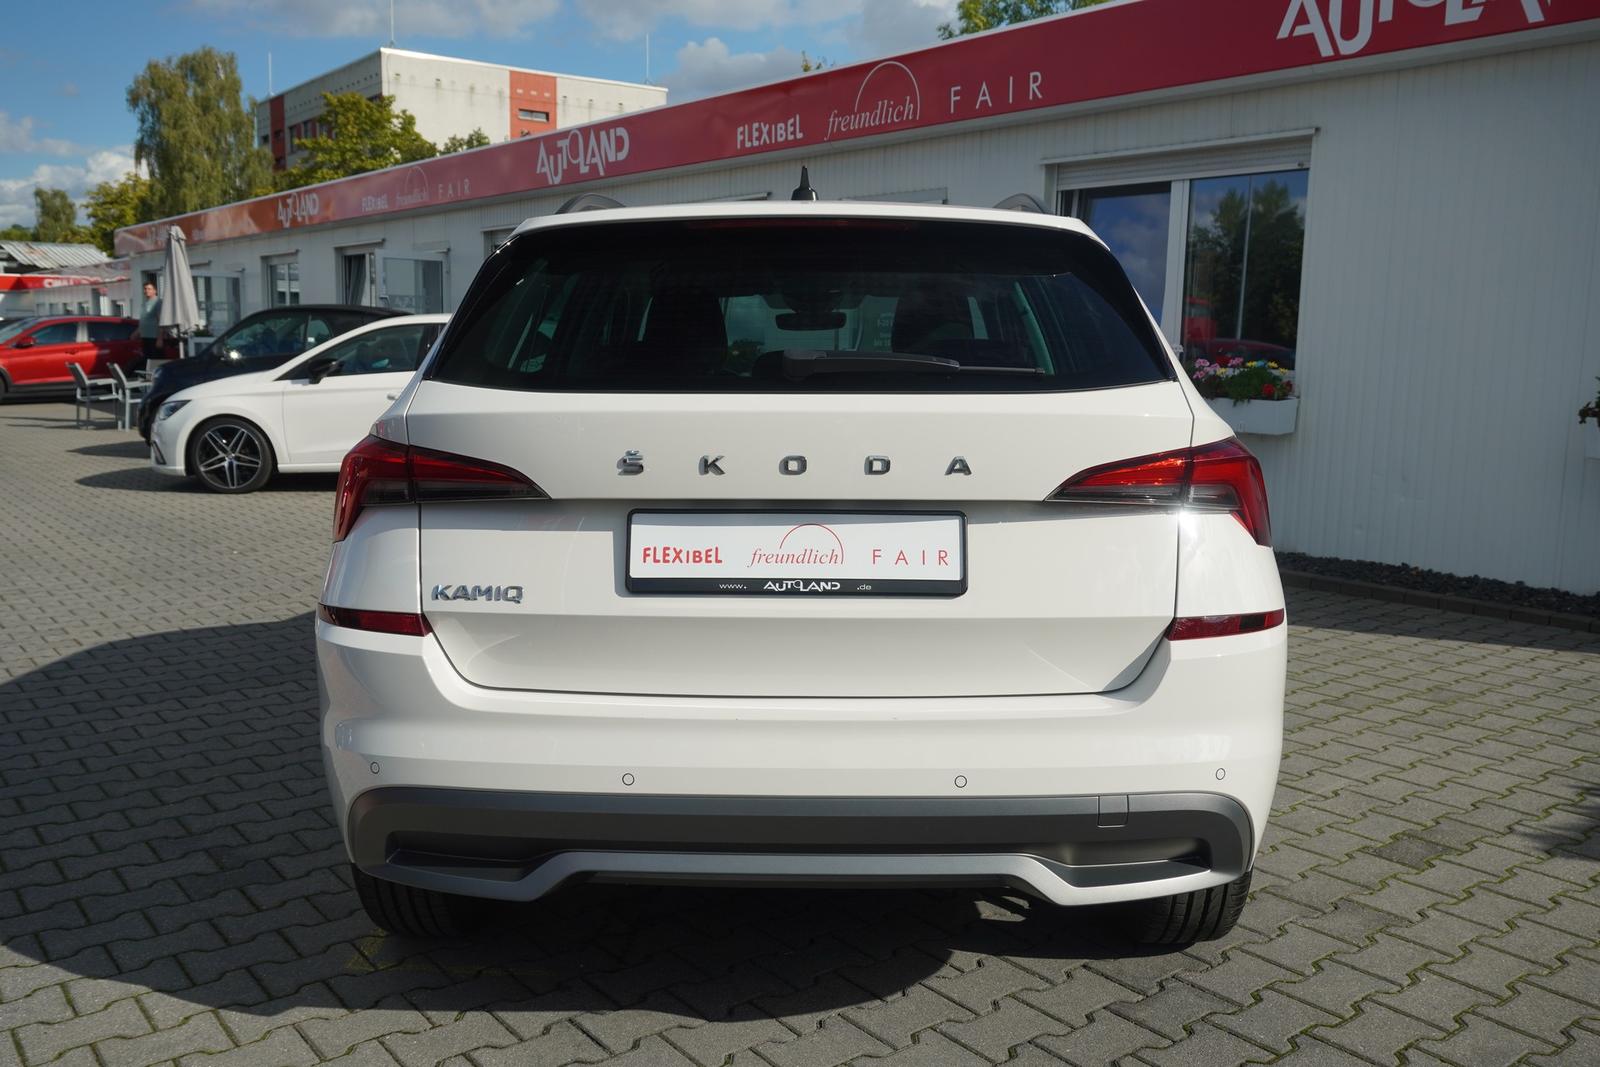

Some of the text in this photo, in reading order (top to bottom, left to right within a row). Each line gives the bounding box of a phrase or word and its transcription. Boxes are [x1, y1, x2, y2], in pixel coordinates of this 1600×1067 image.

[736, 71, 1044, 149] FLEXIBEL freundlich FAIR
[536, 126, 631, 185] AUTOLAND
[277, 192, 320, 228] AUTOLAND
[616, 449, 972, 476] ŠKODA
[642, 547, 949, 568] FLEXIBEL freundlich FAIR
[431, 584, 523, 604] KAMIQ
[763, 579, 841, 592] AUTOLAND
[857, 582, 872, 591] .de
